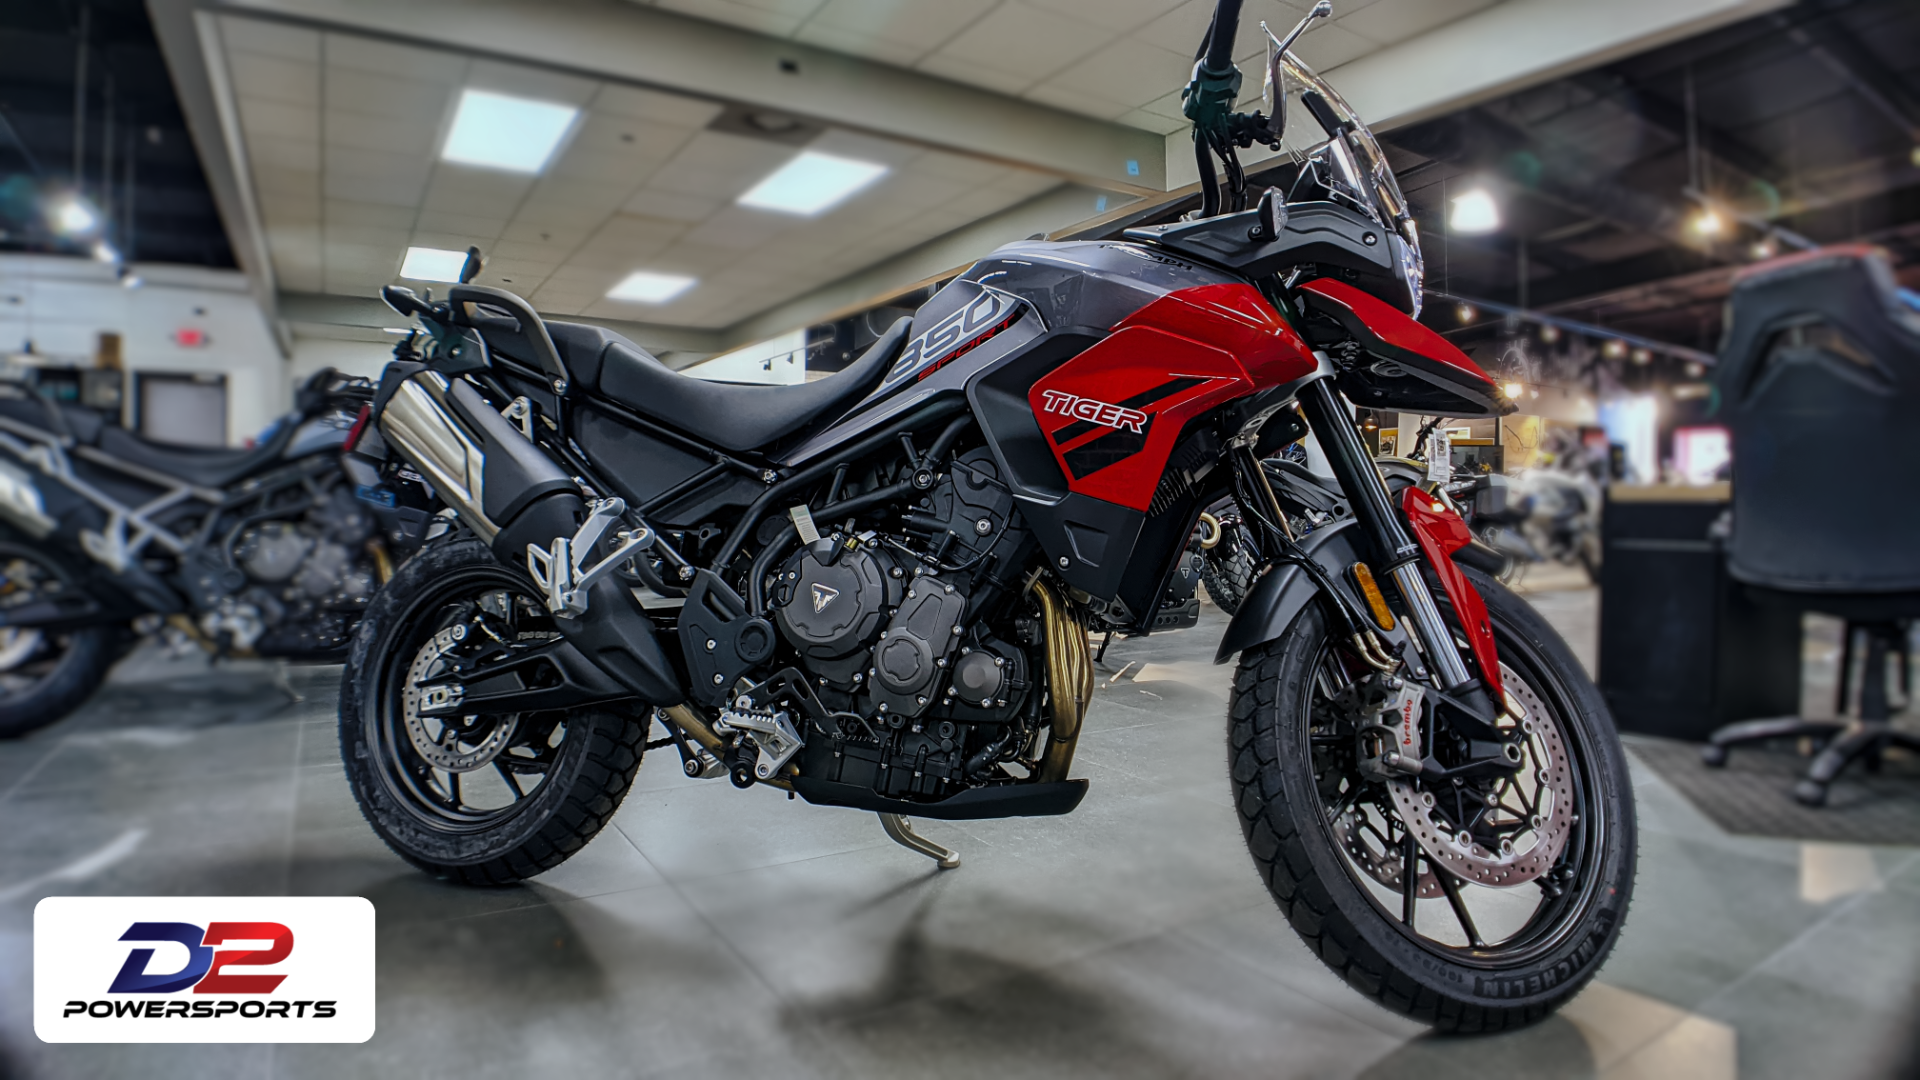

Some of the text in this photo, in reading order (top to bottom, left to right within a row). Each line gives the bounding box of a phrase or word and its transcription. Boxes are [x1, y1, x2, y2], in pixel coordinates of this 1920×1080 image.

[918, 313, 1015, 382] SPORT
[1042, 389, 1148, 435] TIGER
[1403, 699, 1413, 746] brembo
[1483, 936, 1597, 996] MICHELIN
